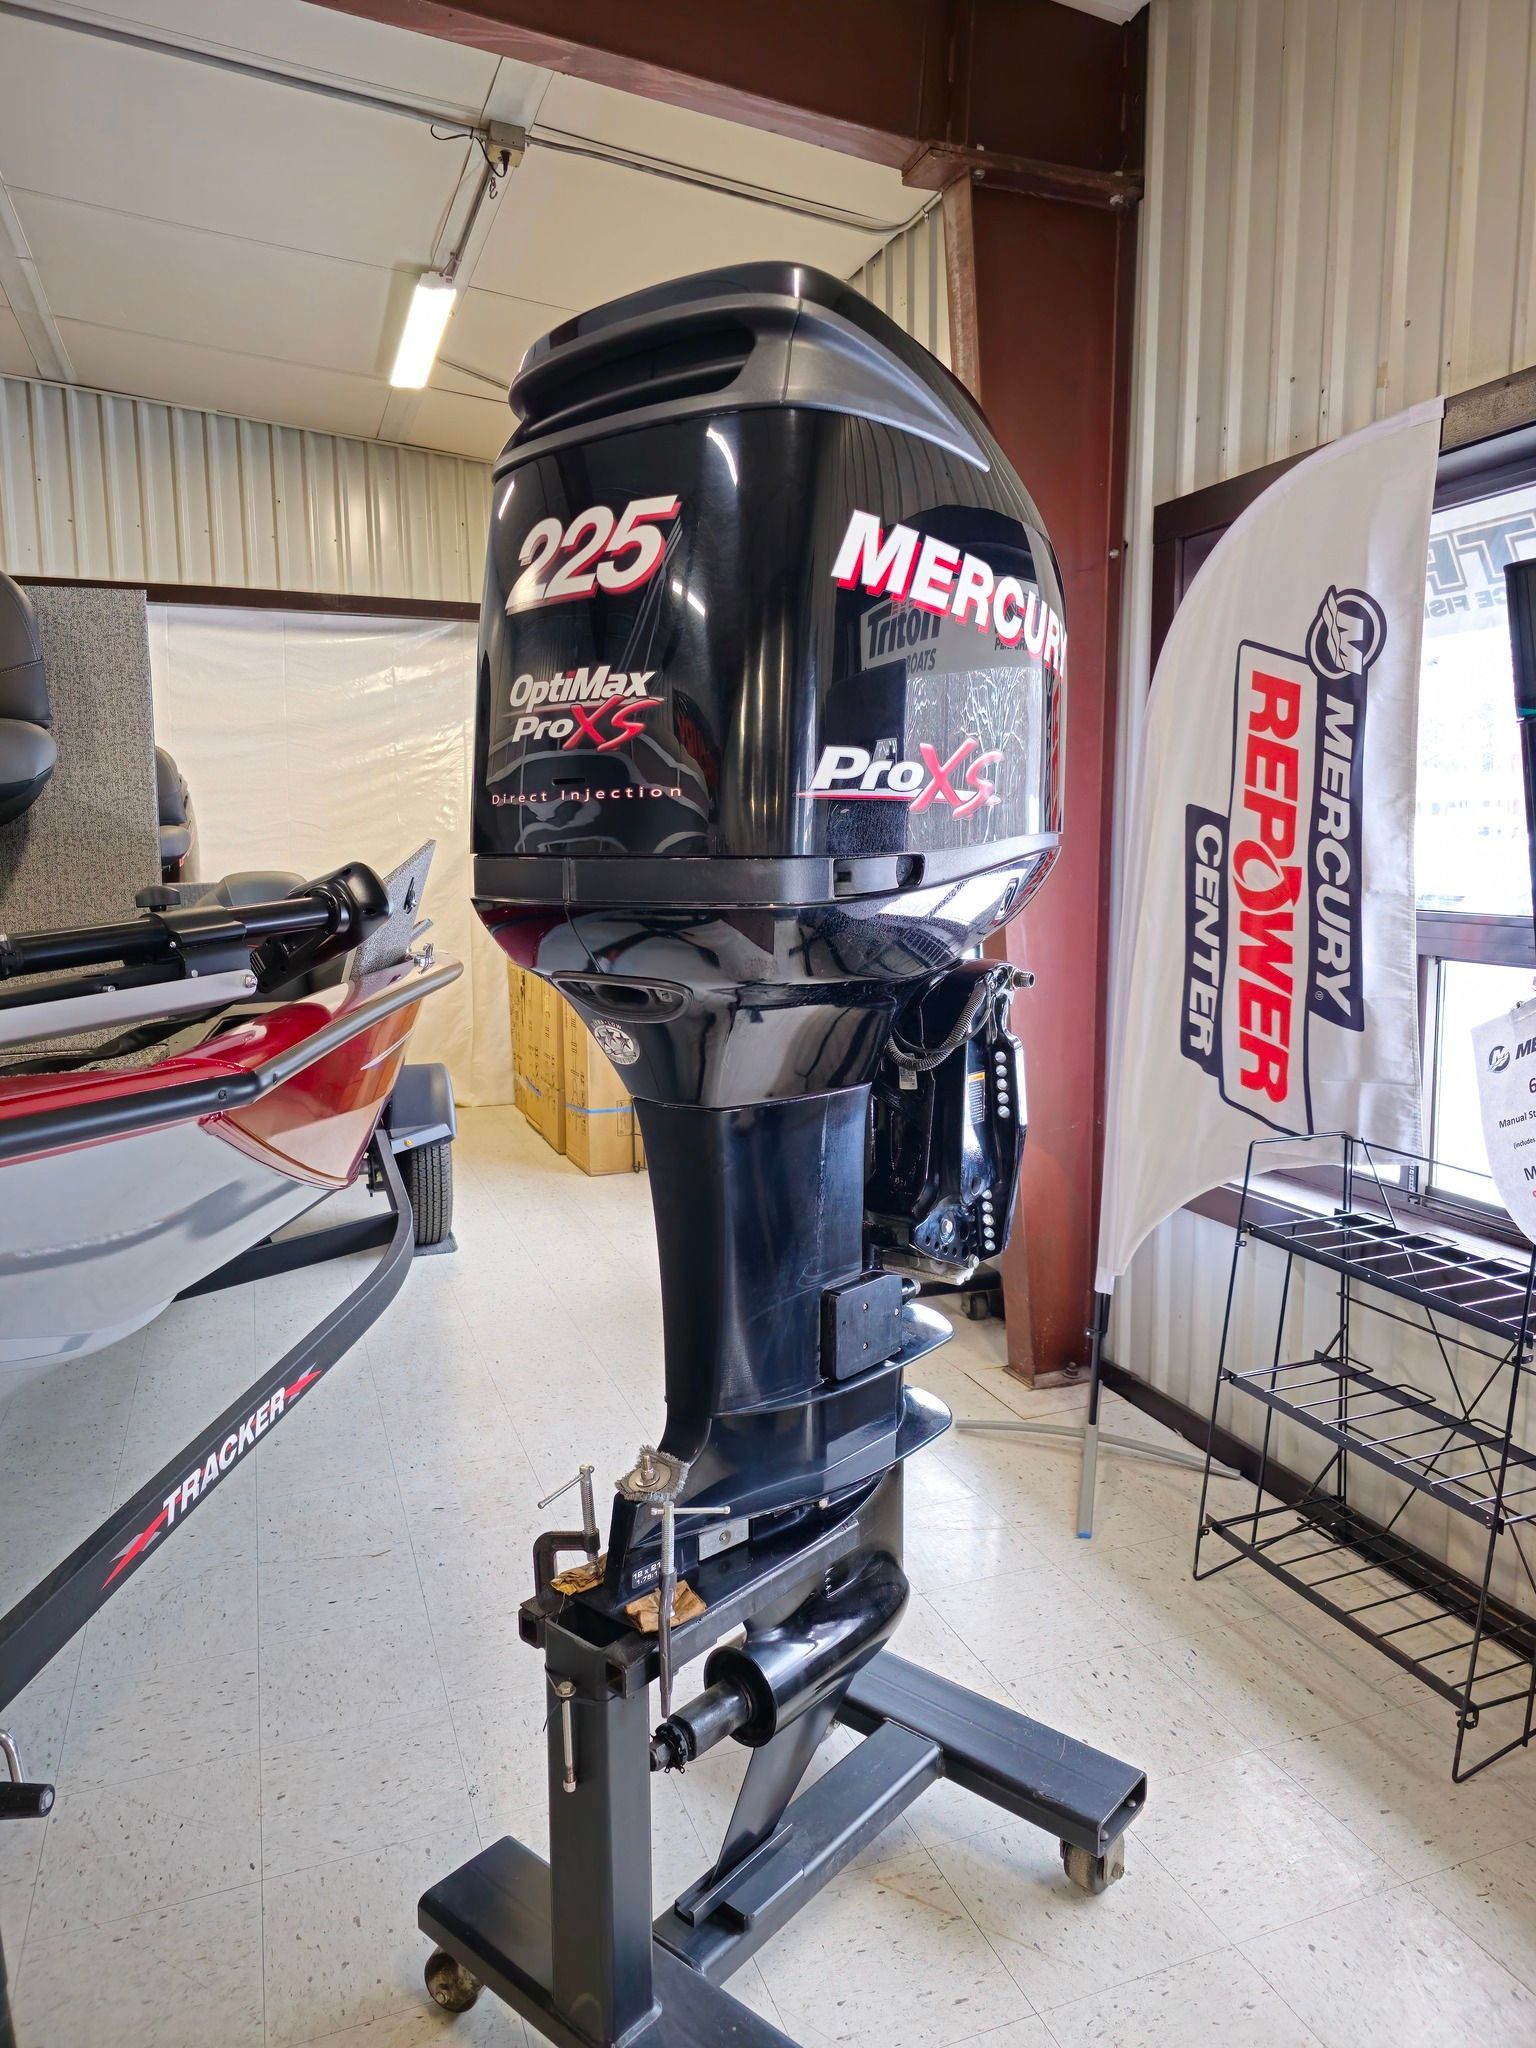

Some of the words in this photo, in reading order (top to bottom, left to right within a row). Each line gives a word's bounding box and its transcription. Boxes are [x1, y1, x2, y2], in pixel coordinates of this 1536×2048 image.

[505, 494, 682, 616] 225
[510, 664, 657, 714] OptiMax
[491, 790, 548, 806] Direct
[561, 785, 683, 802] Injection
[1314, 693, 1355, 1017] MERCURY
[1188, 822, 1223, 1057] CENTER
[1232, 669, 1303, 1104] REPOWER
[1499, 1112, 1527, 1129] Manual
[163, 1386, 286, 1527] TRACKER
